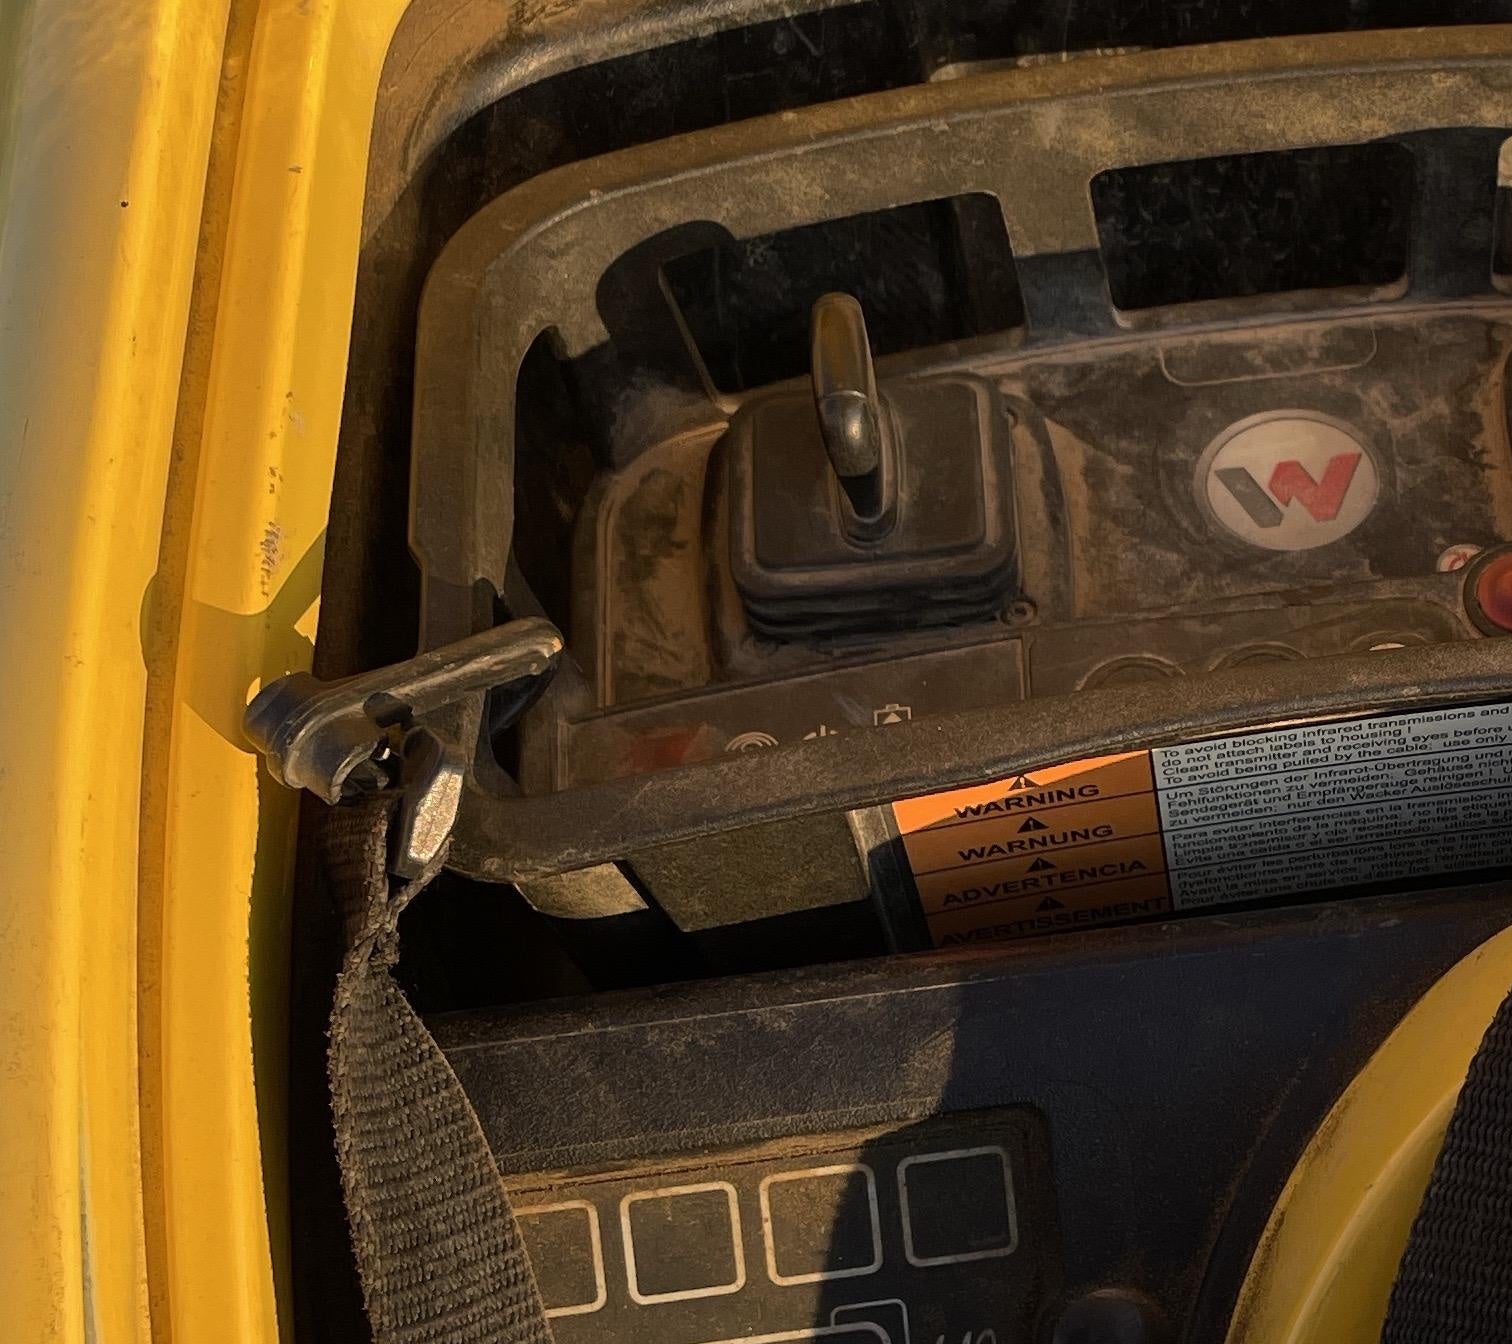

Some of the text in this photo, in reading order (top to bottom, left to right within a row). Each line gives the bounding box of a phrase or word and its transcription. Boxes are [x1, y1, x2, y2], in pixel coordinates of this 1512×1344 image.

[1160, 747, 1178, 758] To
[1184, 741, 1226, 755] avoid
[1232, 731, 1297, 751] blocking
[1303, 723, 1362, 739] infrared
[1367, 711, 1474, 731] transmissions
[1480, 706, 1509, 718] and
[955, 784, 1100, 819] WARNING
[957, 824, 1114, 861] WARNUNG
[942, 860, 1147, 906] ADVERTENCIA
[941, 896, 1167, 945] AVERTISSEMENT
